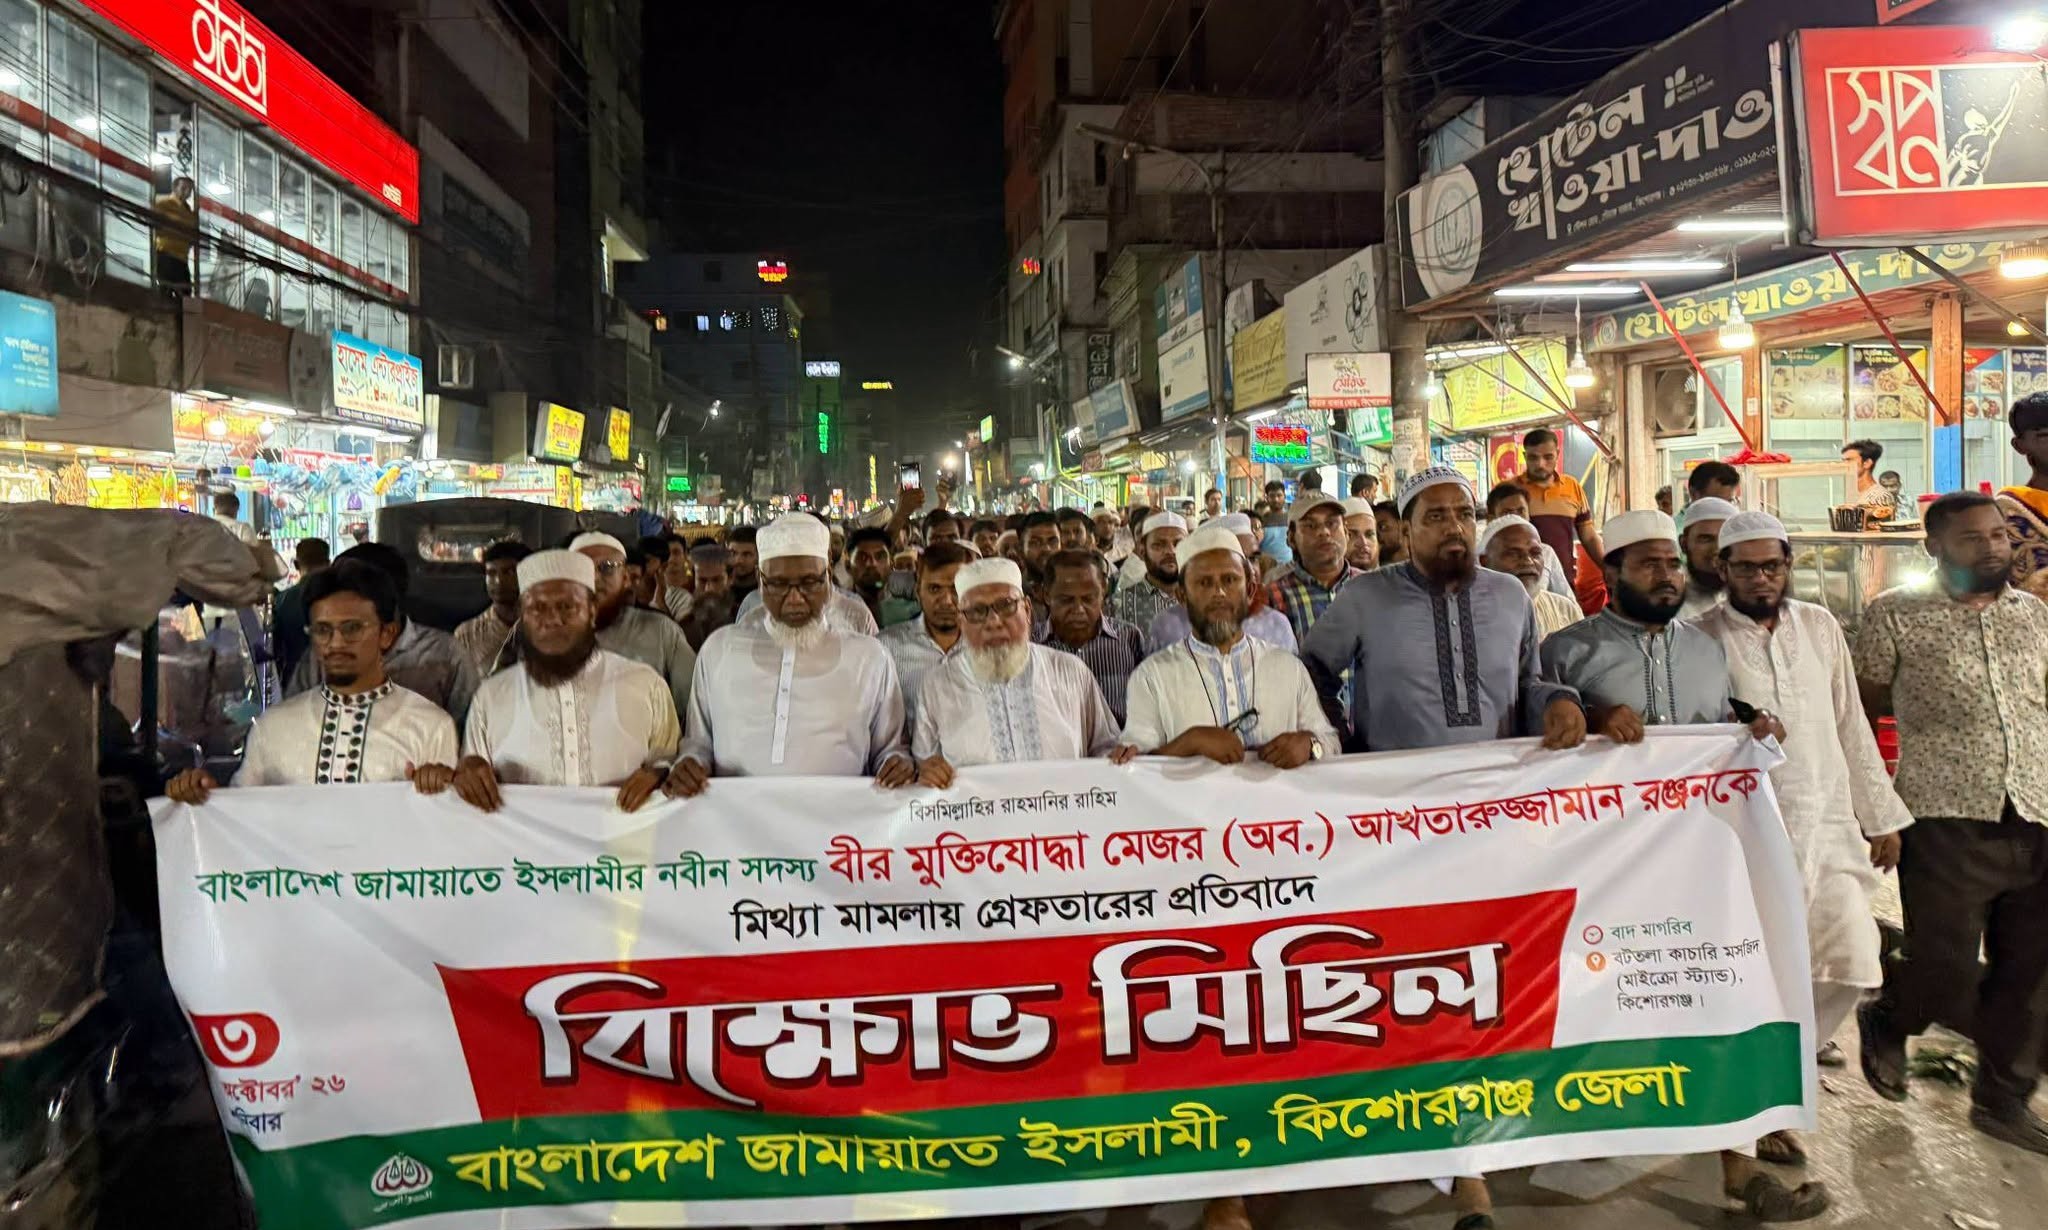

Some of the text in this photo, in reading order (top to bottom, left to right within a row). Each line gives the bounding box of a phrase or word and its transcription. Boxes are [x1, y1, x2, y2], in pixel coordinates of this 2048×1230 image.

[1497, 84, 1646, 212] হোটেল
[909, 786, 1118, 822] বিসমিল্লাহির রাহমানির রাহিম
[826, 767, 1761, 889] বীর মুক্তিযোদ্ধা মেজর (অব.) আখতারুজ্জামান রঞ্জনকে
[196, 850, 819, 903] বাংলাদেশ জামায়াতে ইসলামীর নবীন সদস্য
[731, 875, 1318, 940] মিথ্যা মামলায় গ্রেফতারের প্রতিবাদে
[1609, 917, 1693, 940] বাদ মাগরিব
[1613, 938, 1760, 965] বটতলা কাচারি মসজিদ
[1616, 967, 1744, 992] (মাইক্রো স্ট্যান্ড),
[523, 922, 1508, 1107] বিক্ষোভ মিছিল
[1617, 993, 1694, 1012] কিশোরগঞ্জ
[211, 1020, 257, 1064] ৩
[311, 1075, 346, 1095] ২৬
[447, 1133, 726, 1192] বাংলাদেশ
[737, 1130, 1005, 1178] জামায়াতে
[1268, 1076, 1535, 1146] কিশোরগঞ্জ
[1555, 1061, 1691, 1113] জেলা
